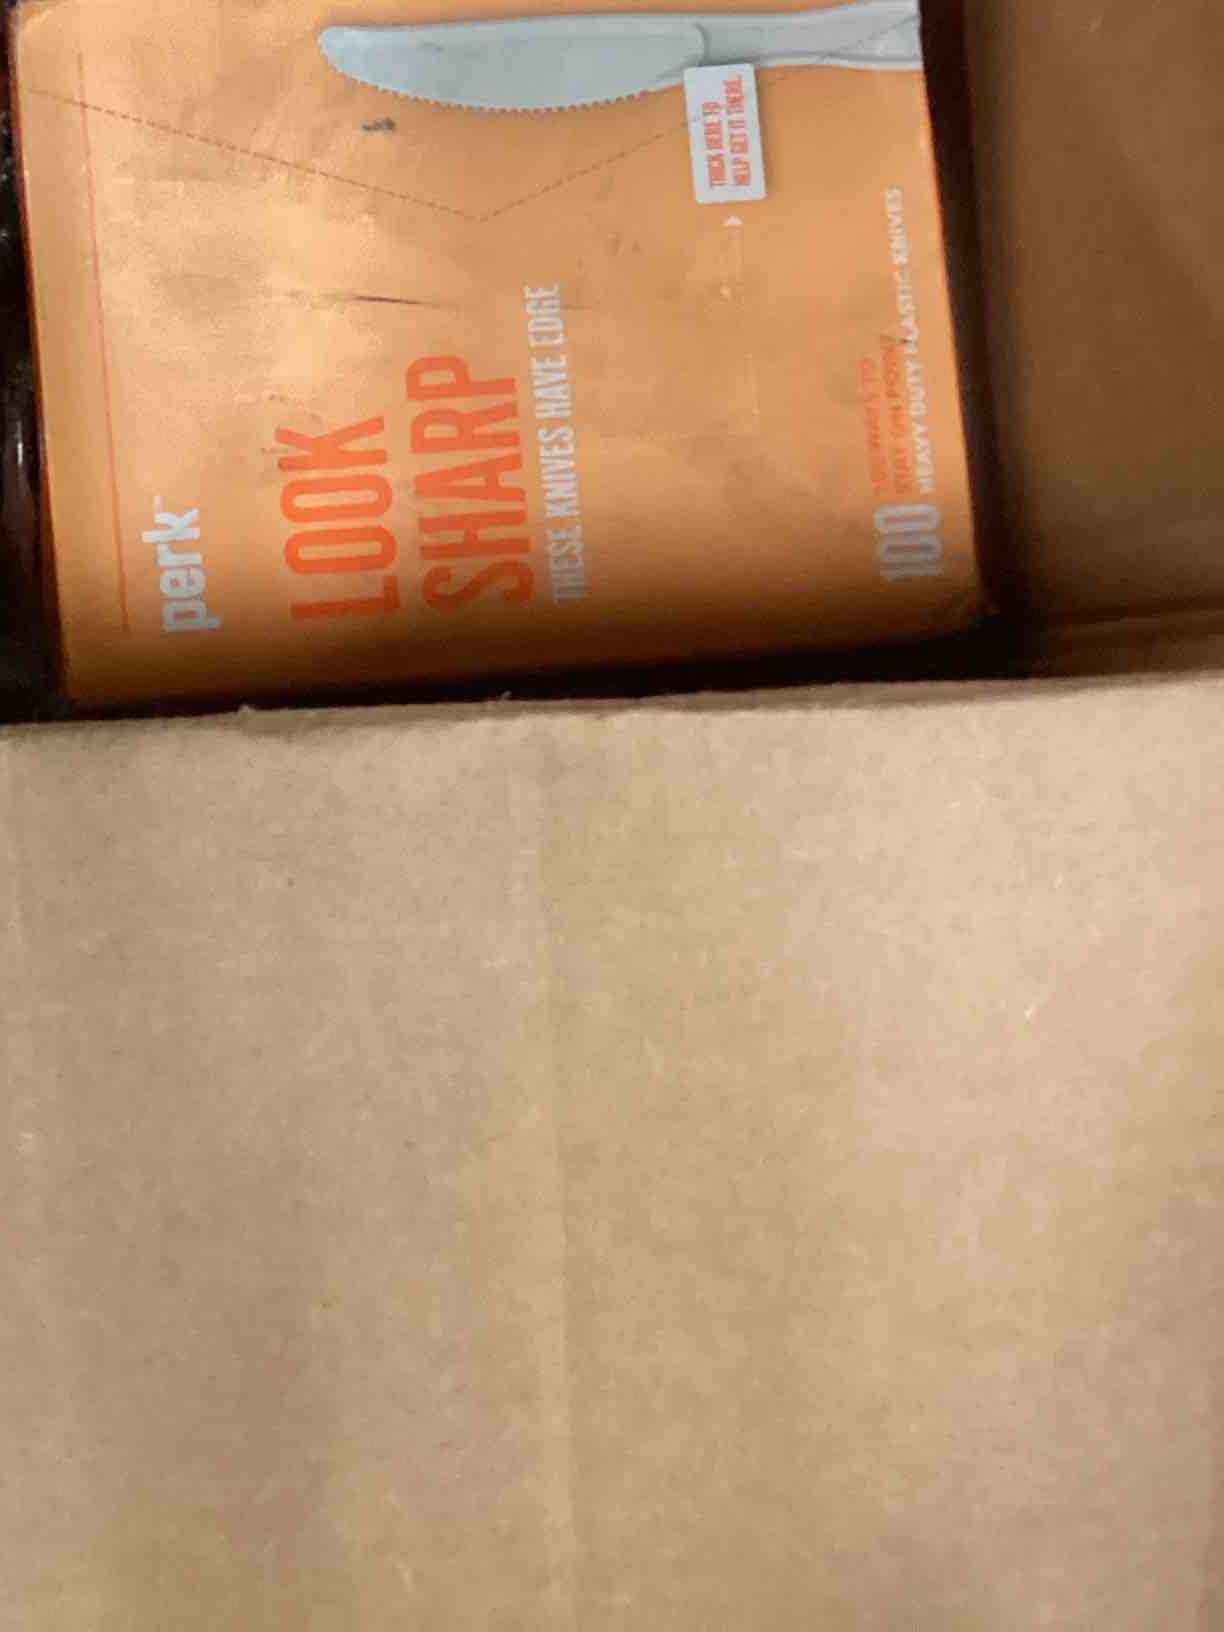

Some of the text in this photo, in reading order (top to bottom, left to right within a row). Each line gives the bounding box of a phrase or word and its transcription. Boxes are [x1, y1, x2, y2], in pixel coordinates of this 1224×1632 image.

[880, 188, 908, 265] KNIVES
[524, 283, 585, 605] THESE KNIVES HAVE EDGE
[904, 361, 928, 416] DUTY
[276, 416, 401, 620] LOOK
[406, 355, 536, 611] SHARP
[874, 503, 946, 580] 100
[142, 508, 222, 633] perk
